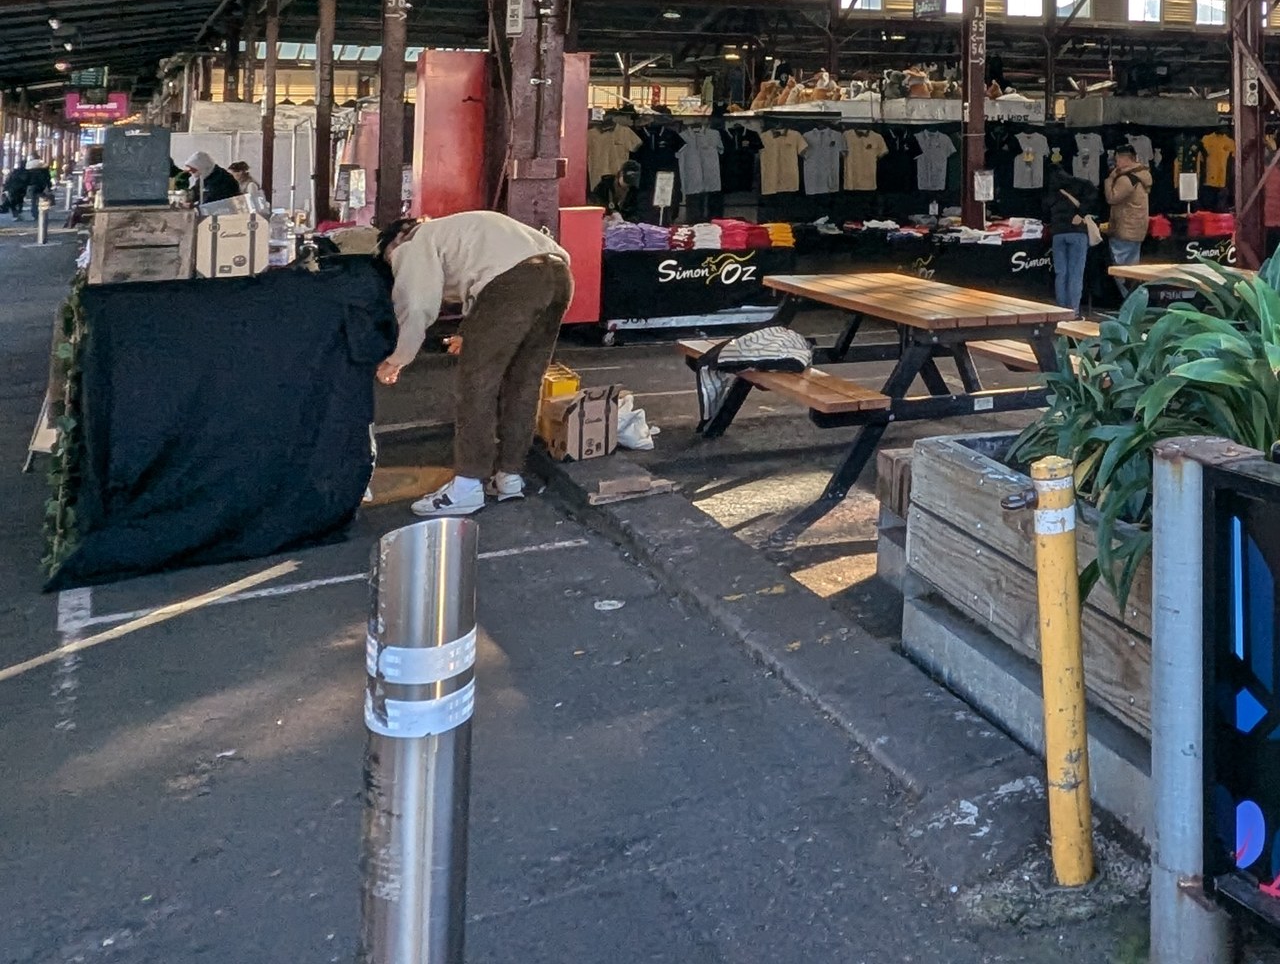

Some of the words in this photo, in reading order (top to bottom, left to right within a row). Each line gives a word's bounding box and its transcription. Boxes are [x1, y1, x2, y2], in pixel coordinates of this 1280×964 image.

[974, 6, 983, 17] L
[972, 19, 984, 32] 55
[971, 43, 984, 55] 54
[1186, 241, 1220, 259] Simon
[1011, 251, 1052, 272] Simon
[658, 259, 709, 282] Simon
